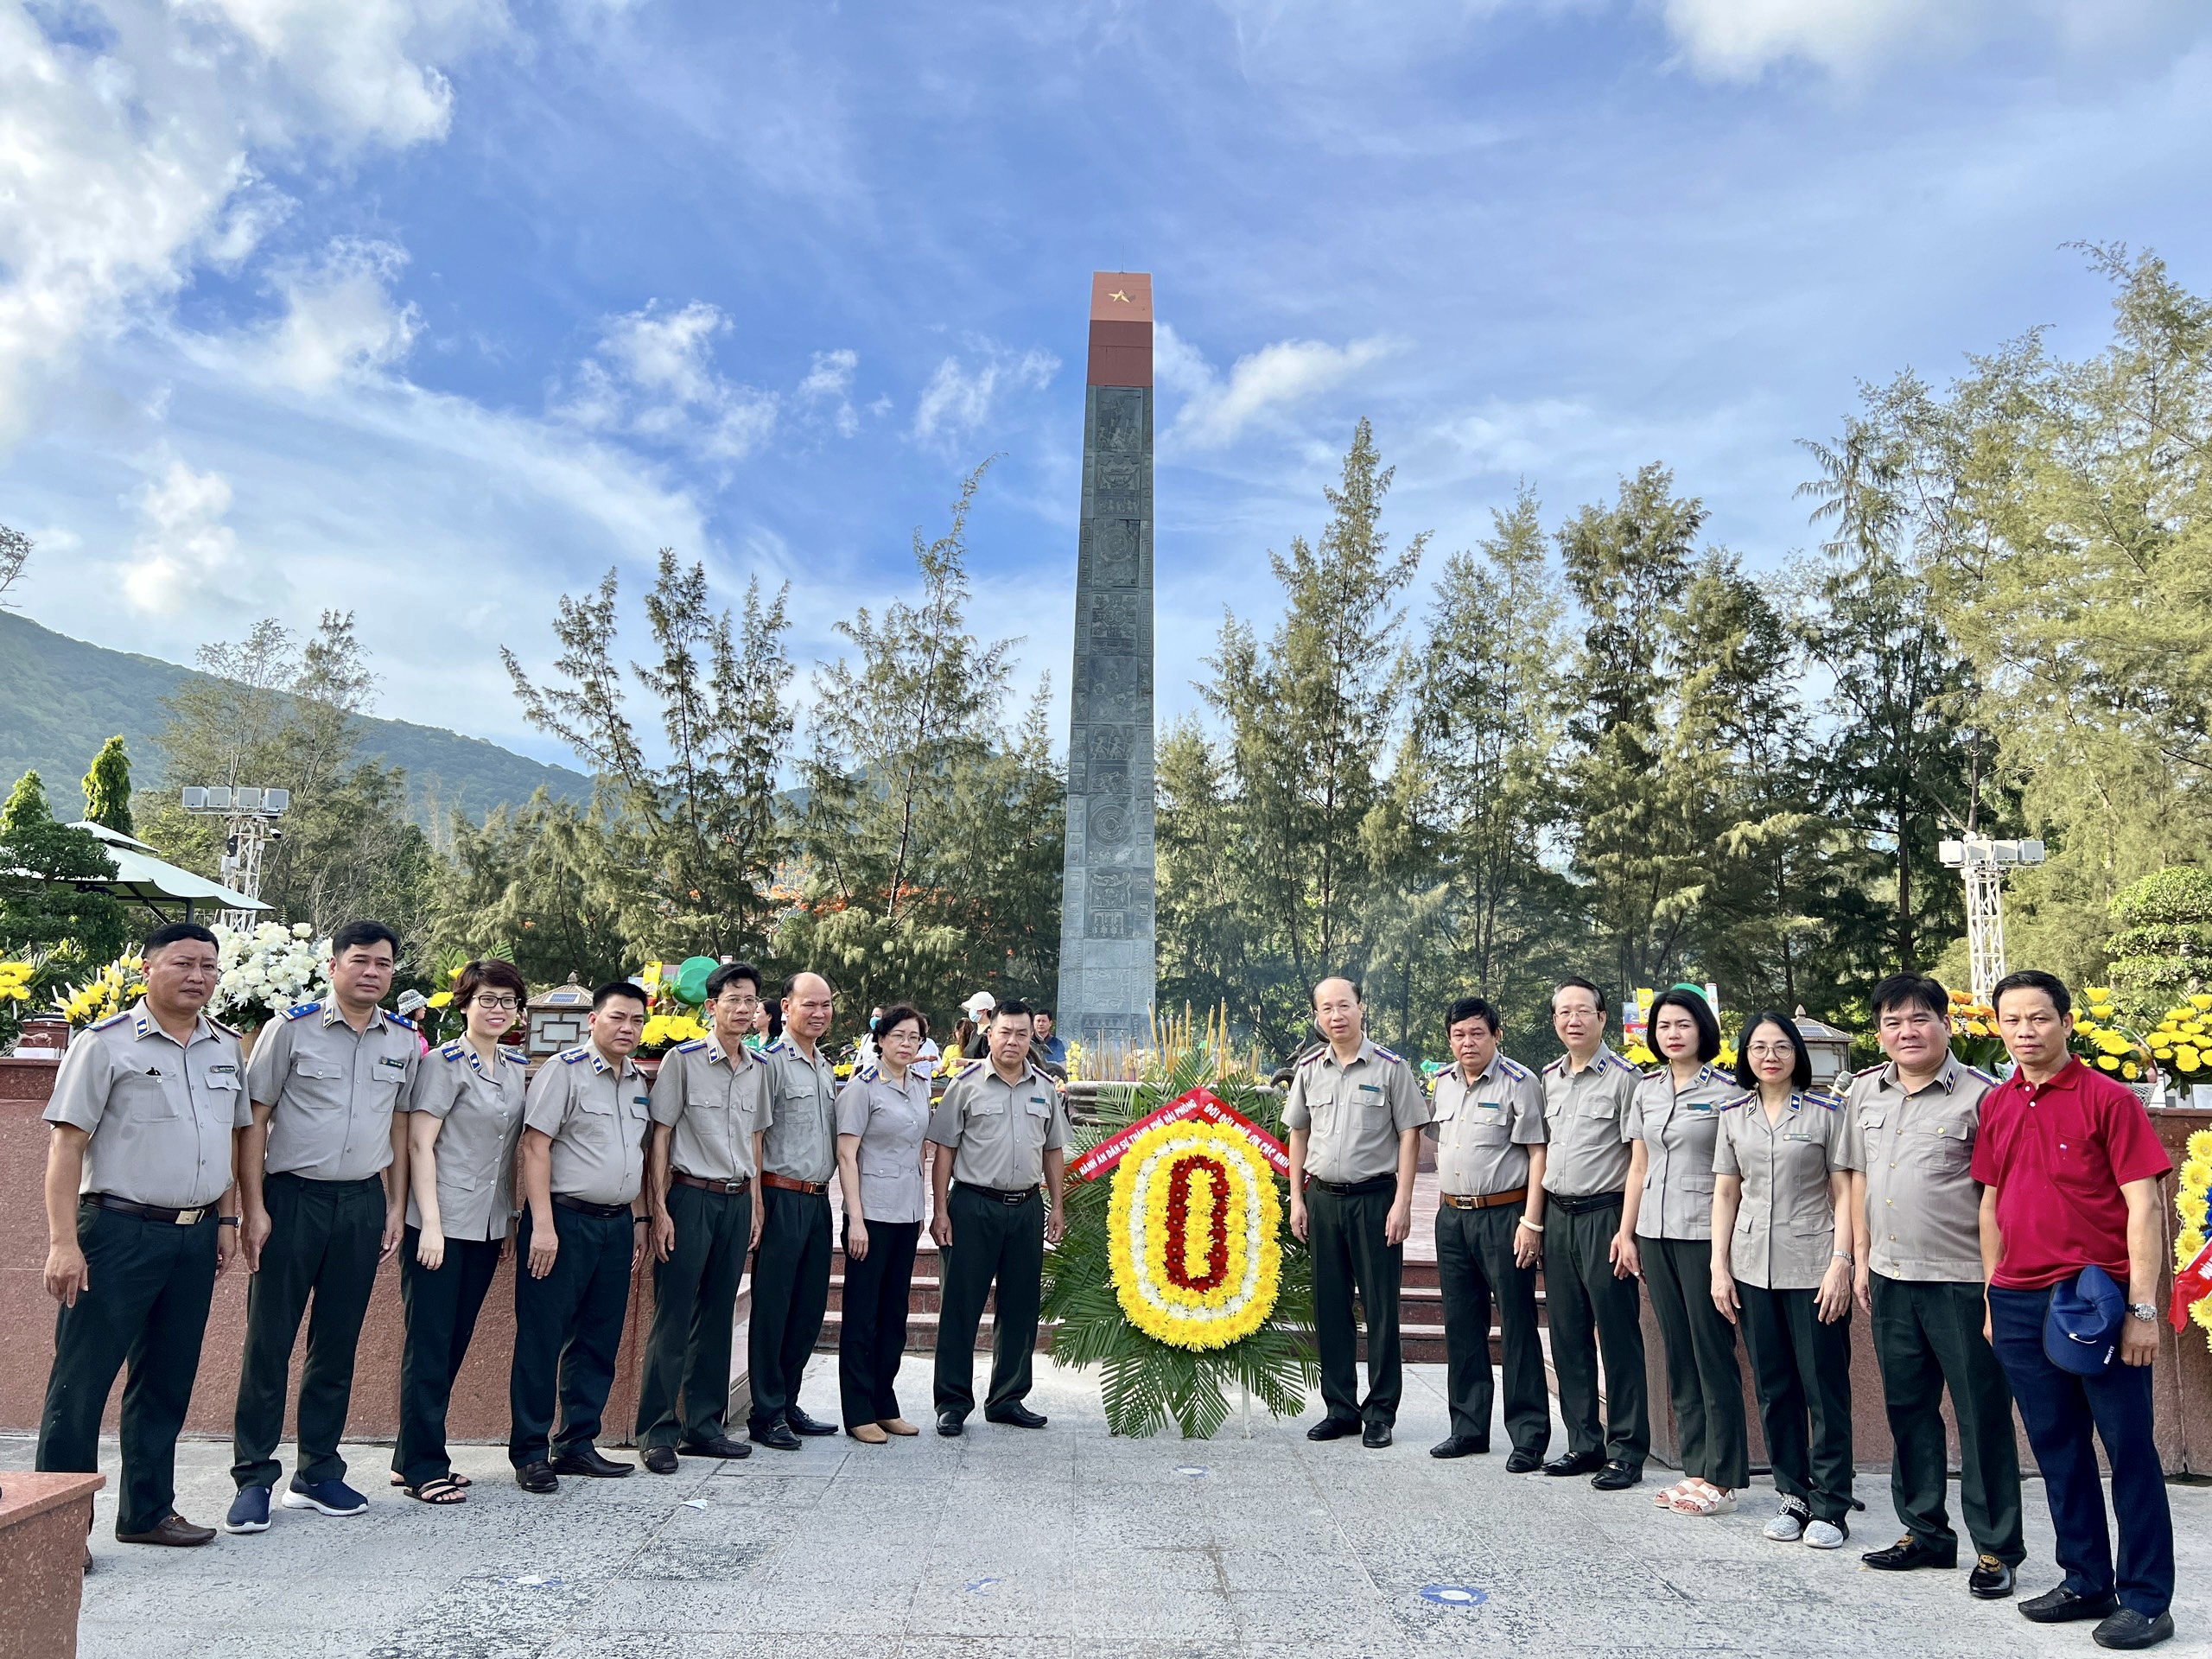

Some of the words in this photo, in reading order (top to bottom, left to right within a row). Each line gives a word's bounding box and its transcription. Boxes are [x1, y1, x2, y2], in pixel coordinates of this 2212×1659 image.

[1078, 1158, 1098, 1176] HÀNH
[1096, 1150, 1108, 1166] ÁN
[1106, 1143, 1122, 1160] DÂN
[1149, 1114, 1166, 1131] PHỐ
[1163, 1109, 1177, 1125] HẢI
[1175, 1098, 1198, 1118] PHÒNG
[1204, 1102, 1221, 1119] ĐỜI
[1249, 1134, 1262, 1147] ƠN
[1259, 1141, 1276, 1158] CÁC
[1273, 1152, 1289, 1169] ANH
